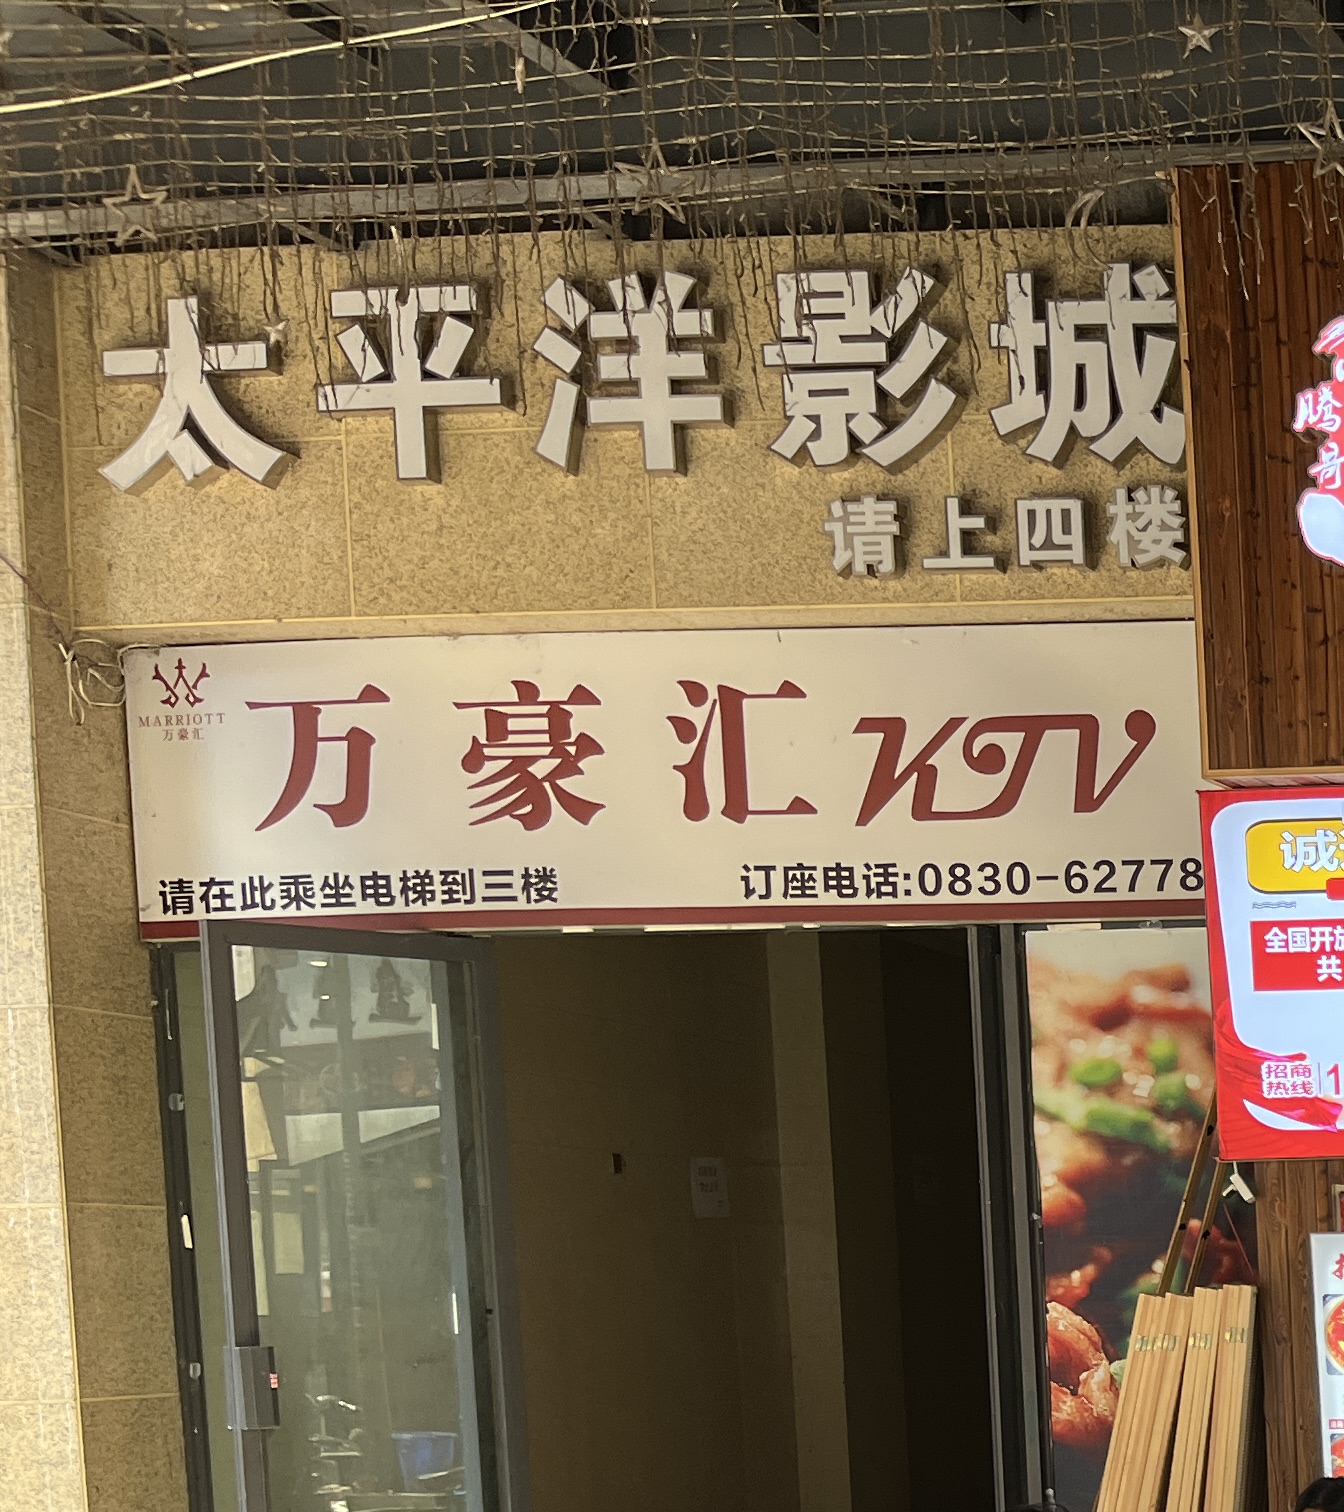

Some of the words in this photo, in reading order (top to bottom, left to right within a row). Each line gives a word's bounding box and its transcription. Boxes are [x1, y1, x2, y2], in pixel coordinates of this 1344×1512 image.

[98, 261, 1188, 492] 太平洋影城
[825, 485, 1188, 579] 请上四楼
[138, 712, 226, 728] MARRIOTT
[163, 727, 205, 742] 万豪汇
[244, 678, 818, 834] 万豪汇
[852, 707, 1158, 828] KTV
[158, 866, 560, 917] 请在此乘坐电梯到三楼
[1263, 1062, 1314, 1081] 招商
[1263, 1079, 1315, 1098] 热线
